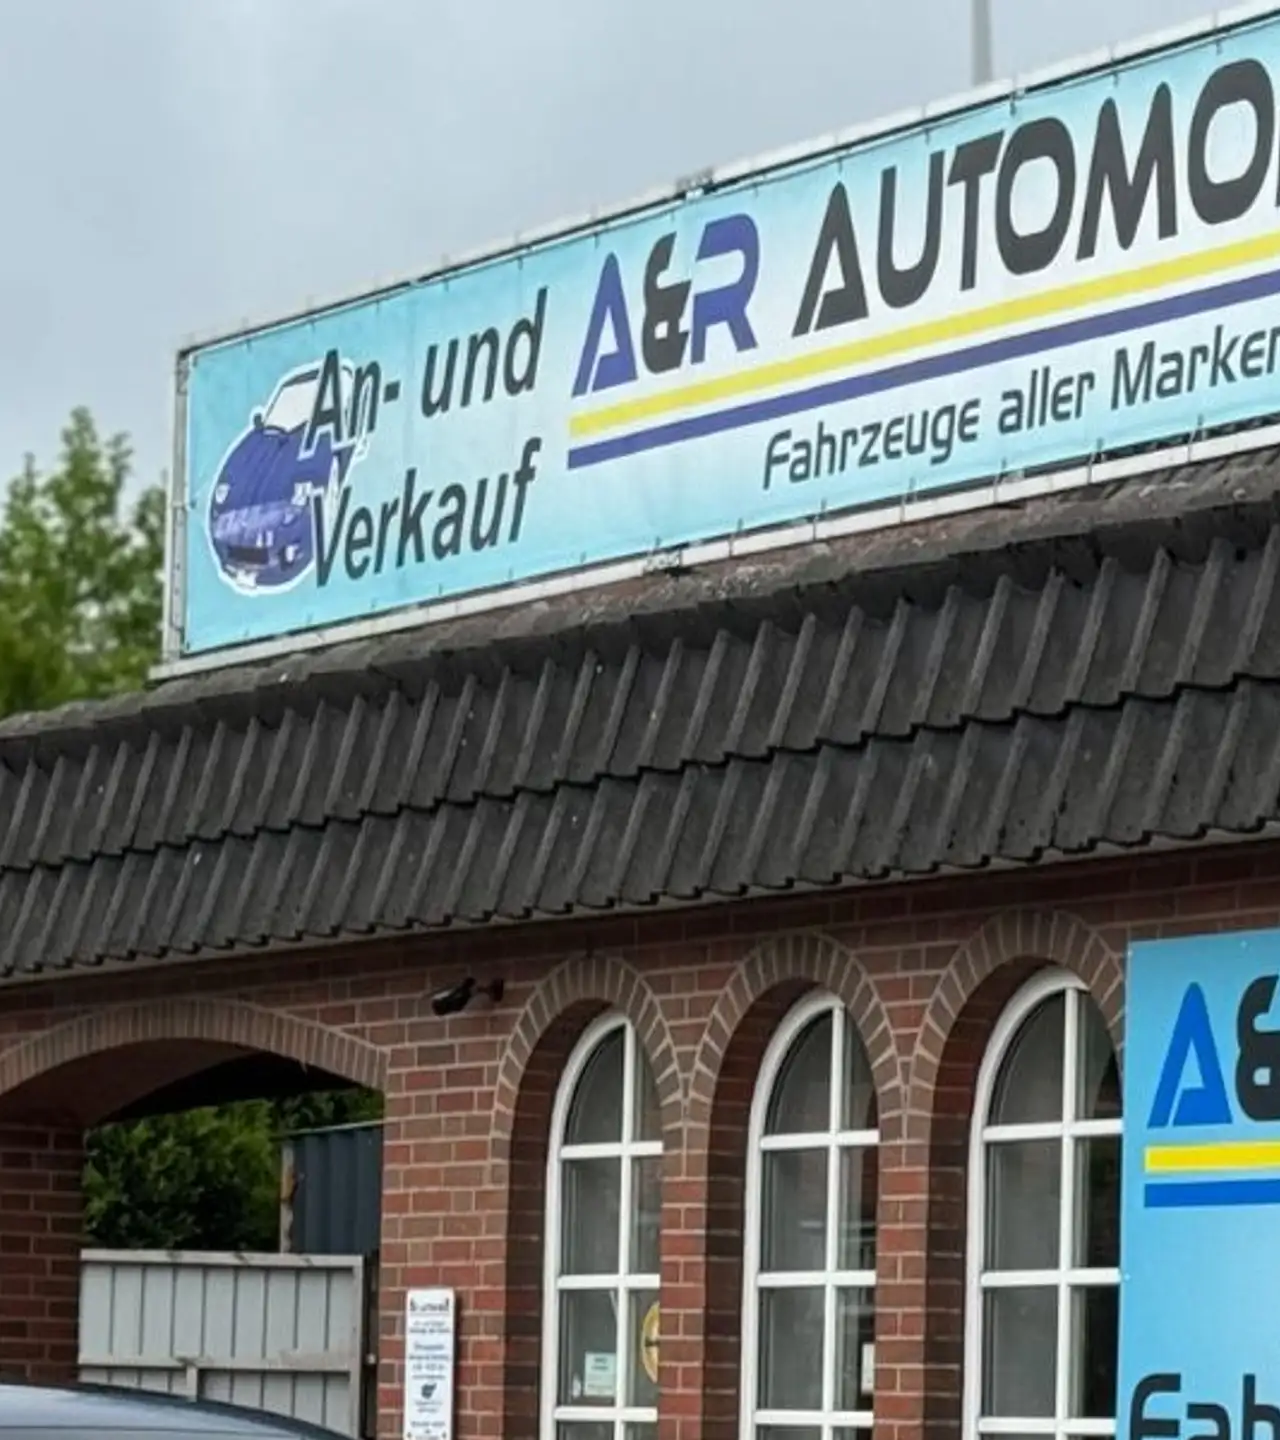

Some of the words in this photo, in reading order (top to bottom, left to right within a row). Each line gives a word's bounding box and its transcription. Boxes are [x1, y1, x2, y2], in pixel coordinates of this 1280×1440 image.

[304, 348, 400, 450] An-
[423, 287, 547, 417] und
[572, 213, 759, 398] A&R
[763, 398, 981, 490] Fahrzeuge
[999, 367, 1096, 436] aller
[315, 438, 541, 587] Verkauf
